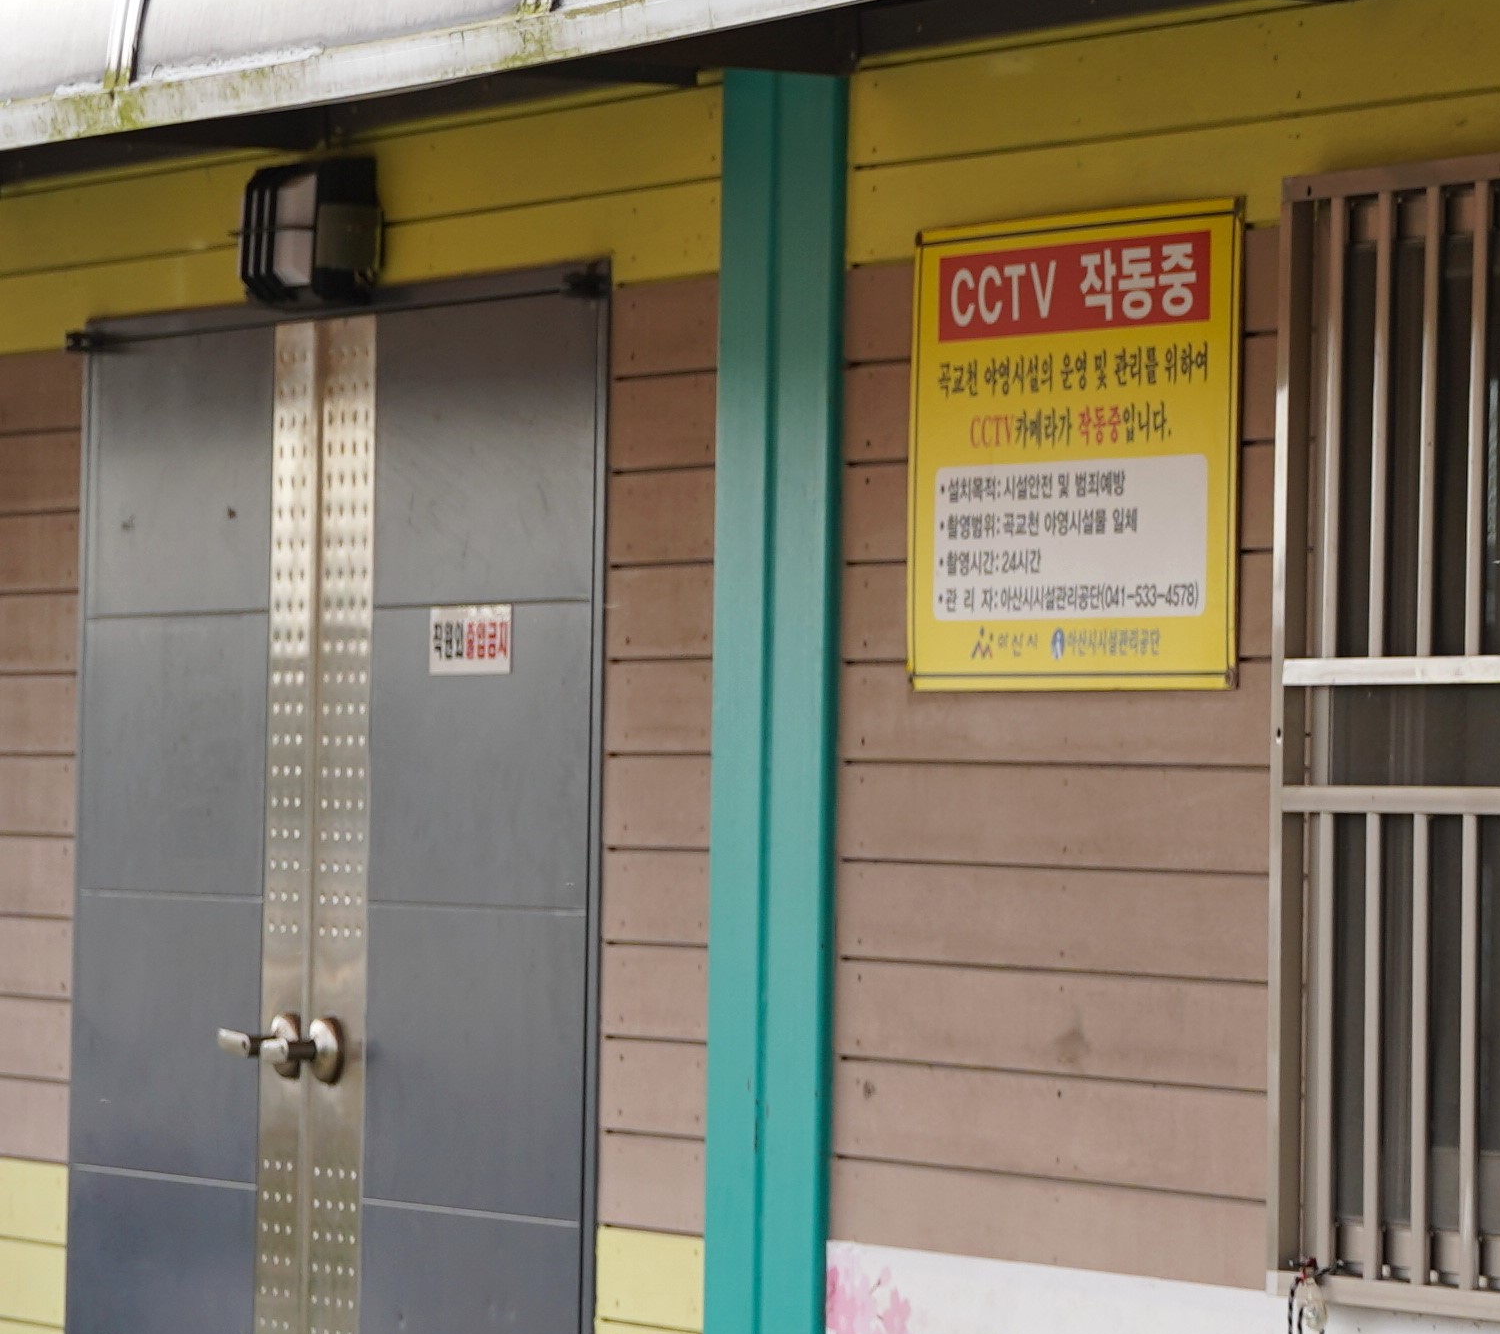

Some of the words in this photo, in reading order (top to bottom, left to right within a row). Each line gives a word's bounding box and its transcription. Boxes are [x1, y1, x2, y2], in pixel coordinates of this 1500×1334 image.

[950, 259, 1056, 327] CCTV
[1080, 243, 1197, 321] 작동중
[938, 359, 978, 397] 곡교천
[984, 352, 1053, 396] 야영시설의
[1061, 350, 1087, 390] 운영
[1095, 349, 1106, 390] 및
[1114, 345, 1158, 386] 관리를
[1165, 341, 1208, 383] 위하여
[970, 407, 1072, 449] CCTV카메라가
[1080, 400, 1171, 445] 작동중입니다.
[948, 477, 1001, 503] 설치목적:
[1004, 473, 1052, 500] 시설안전
[1058, 473, 1069, 496] 및
[1075, 471, 1125, 497] 범죄예방
[1003, 513, 1039, 536] 곡교천
[1044, 509, 1106, 536] 야영시설물
[1112, 507, 1138, 532] 일체
[1002, 548, 1040, 573] 24시간
